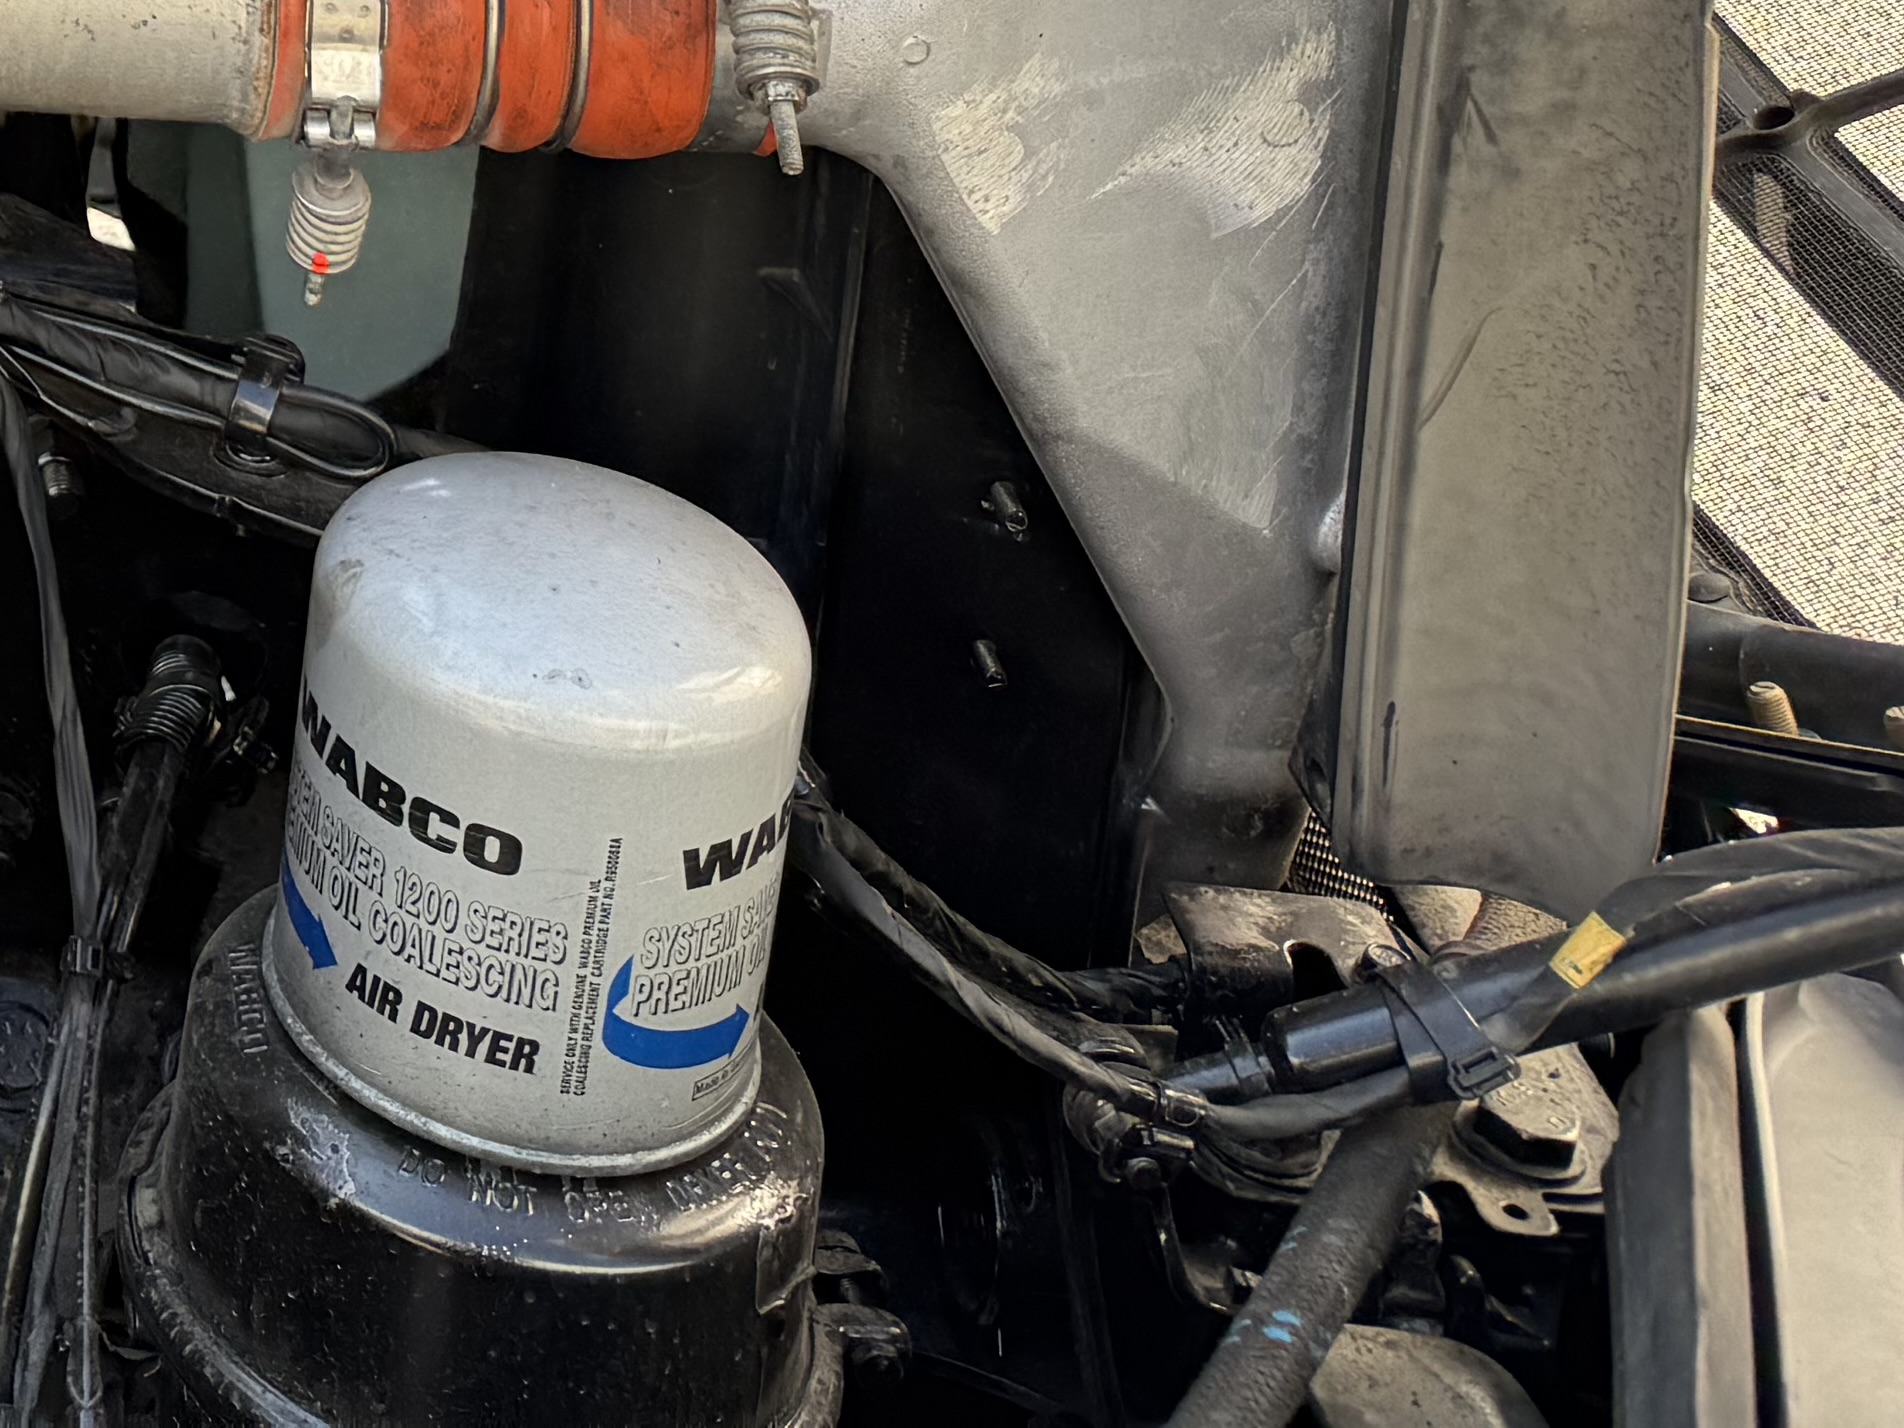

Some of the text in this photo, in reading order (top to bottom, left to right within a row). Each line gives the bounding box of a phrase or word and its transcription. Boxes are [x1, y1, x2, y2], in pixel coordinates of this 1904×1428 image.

[301, 673, 524, 877] WABCO
[322, 803, 386, 899] SAVER
[394, 865, 461, 934] 1200
[464, 899, 569, 968] SERIES
[327, 864, 362, 932] OIL
[368, 899, 560, 1013] COALESCING
[582, 895, 599, 937] PREMIUM
[598, 901, 613, 925] PART
[639, 903, 743, 971] SYSTEM
[577, 937, 593, 970] WABCO
[590, 926, 610, 978] CARTRIDGE
[571, 973, 588, 1011] GENUINE
[632, 943, 746, 1018] PREMIUM
[344, 961, 541, 1076] AIR DRYER
[567, 1011, 582, 1035] WITH
[580, 980, 602, 1043] REPLACEMENT
[564, 1035, 578, 1058] ONLY
[572, 1043, 593, 1097] COALESCING
[559, 1059, 575, 1095] SERVICE
[467, 1165, 539, 1216] NOT
